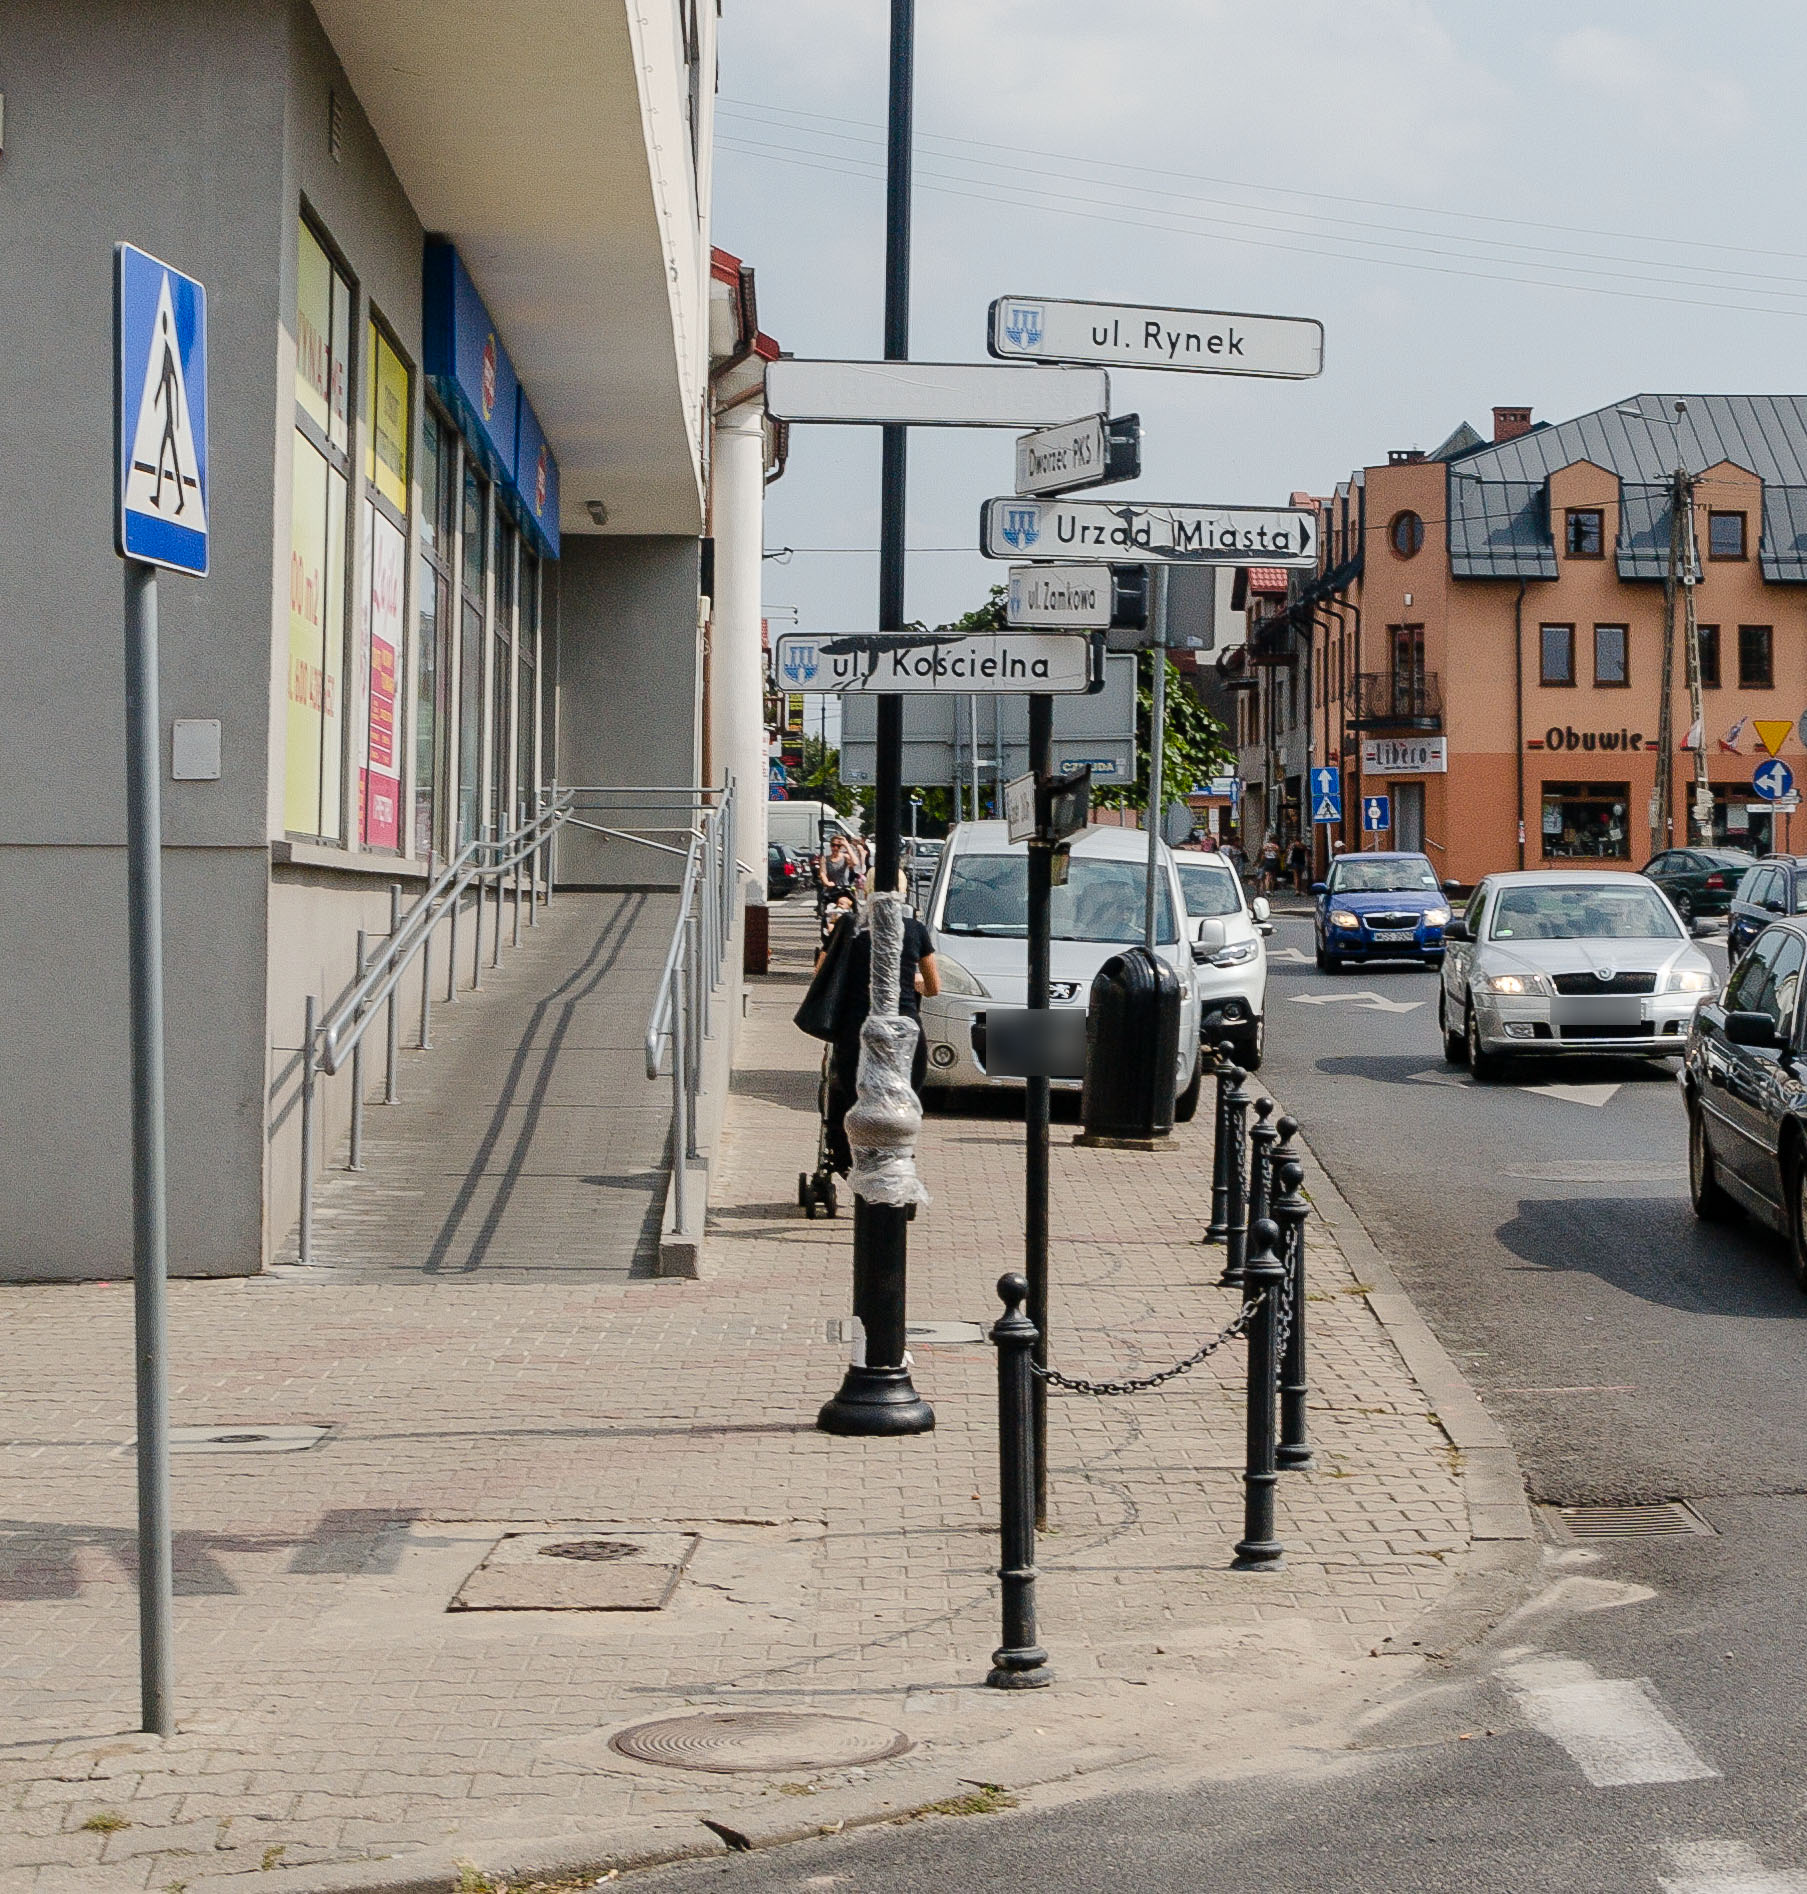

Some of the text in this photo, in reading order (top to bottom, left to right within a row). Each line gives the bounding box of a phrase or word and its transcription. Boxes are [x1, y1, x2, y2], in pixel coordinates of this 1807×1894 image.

[1092, 320, 1245, 359] ul. Rynek
[1029, 434, 1092, 477] Dworzec PKS
[1177, 519, 1290, 551] Miasta
[1028, 581, 1096, 611] ul. Zamkowa
[833, 648, 1049, 679] ul. Kościelna
[1376, 742, 1427, 765] Libero
[1546, 726, 1643, 752] Obuwie
